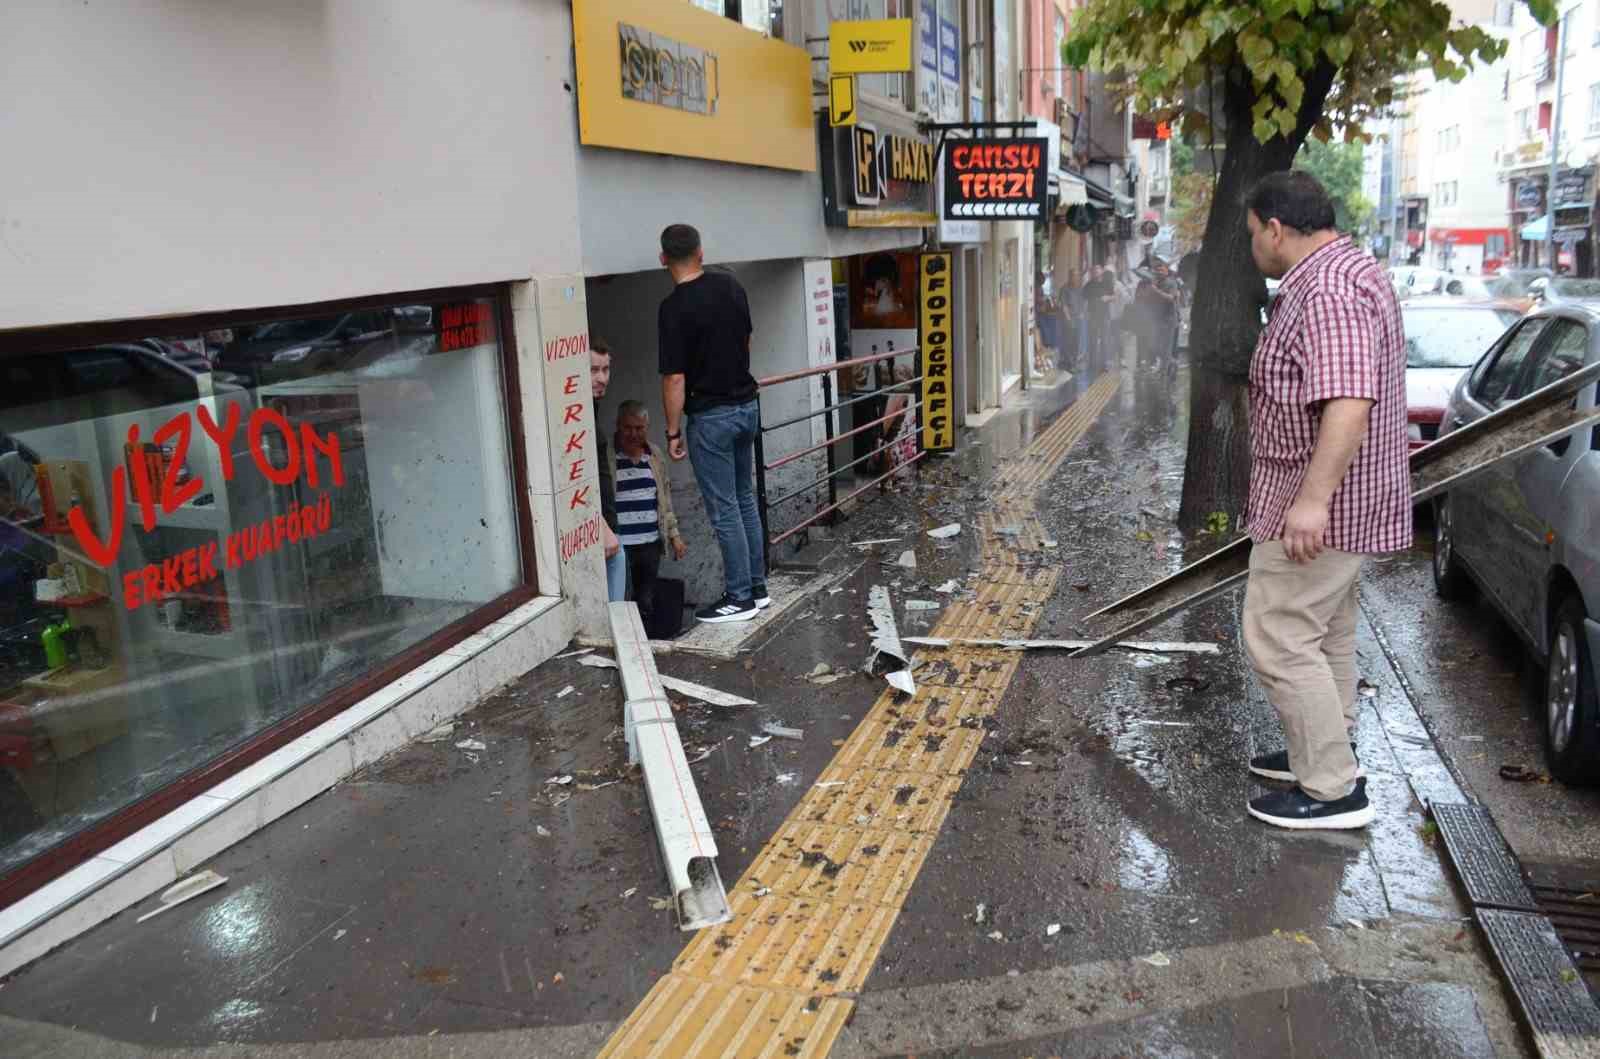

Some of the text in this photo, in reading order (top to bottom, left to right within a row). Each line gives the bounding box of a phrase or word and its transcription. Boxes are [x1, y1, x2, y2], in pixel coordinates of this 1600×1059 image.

[892, 135, 934, 184] HAYAT
[958, 170, 1035, 198] TERZİ
[545, 334, 588, 361] VİZYON
[68, 400, 345, 567] VİZYON
[563, 375, 590, 511] ERKEK
[123, 492, 332, 612] ERKEK KUAFÖRÜ
